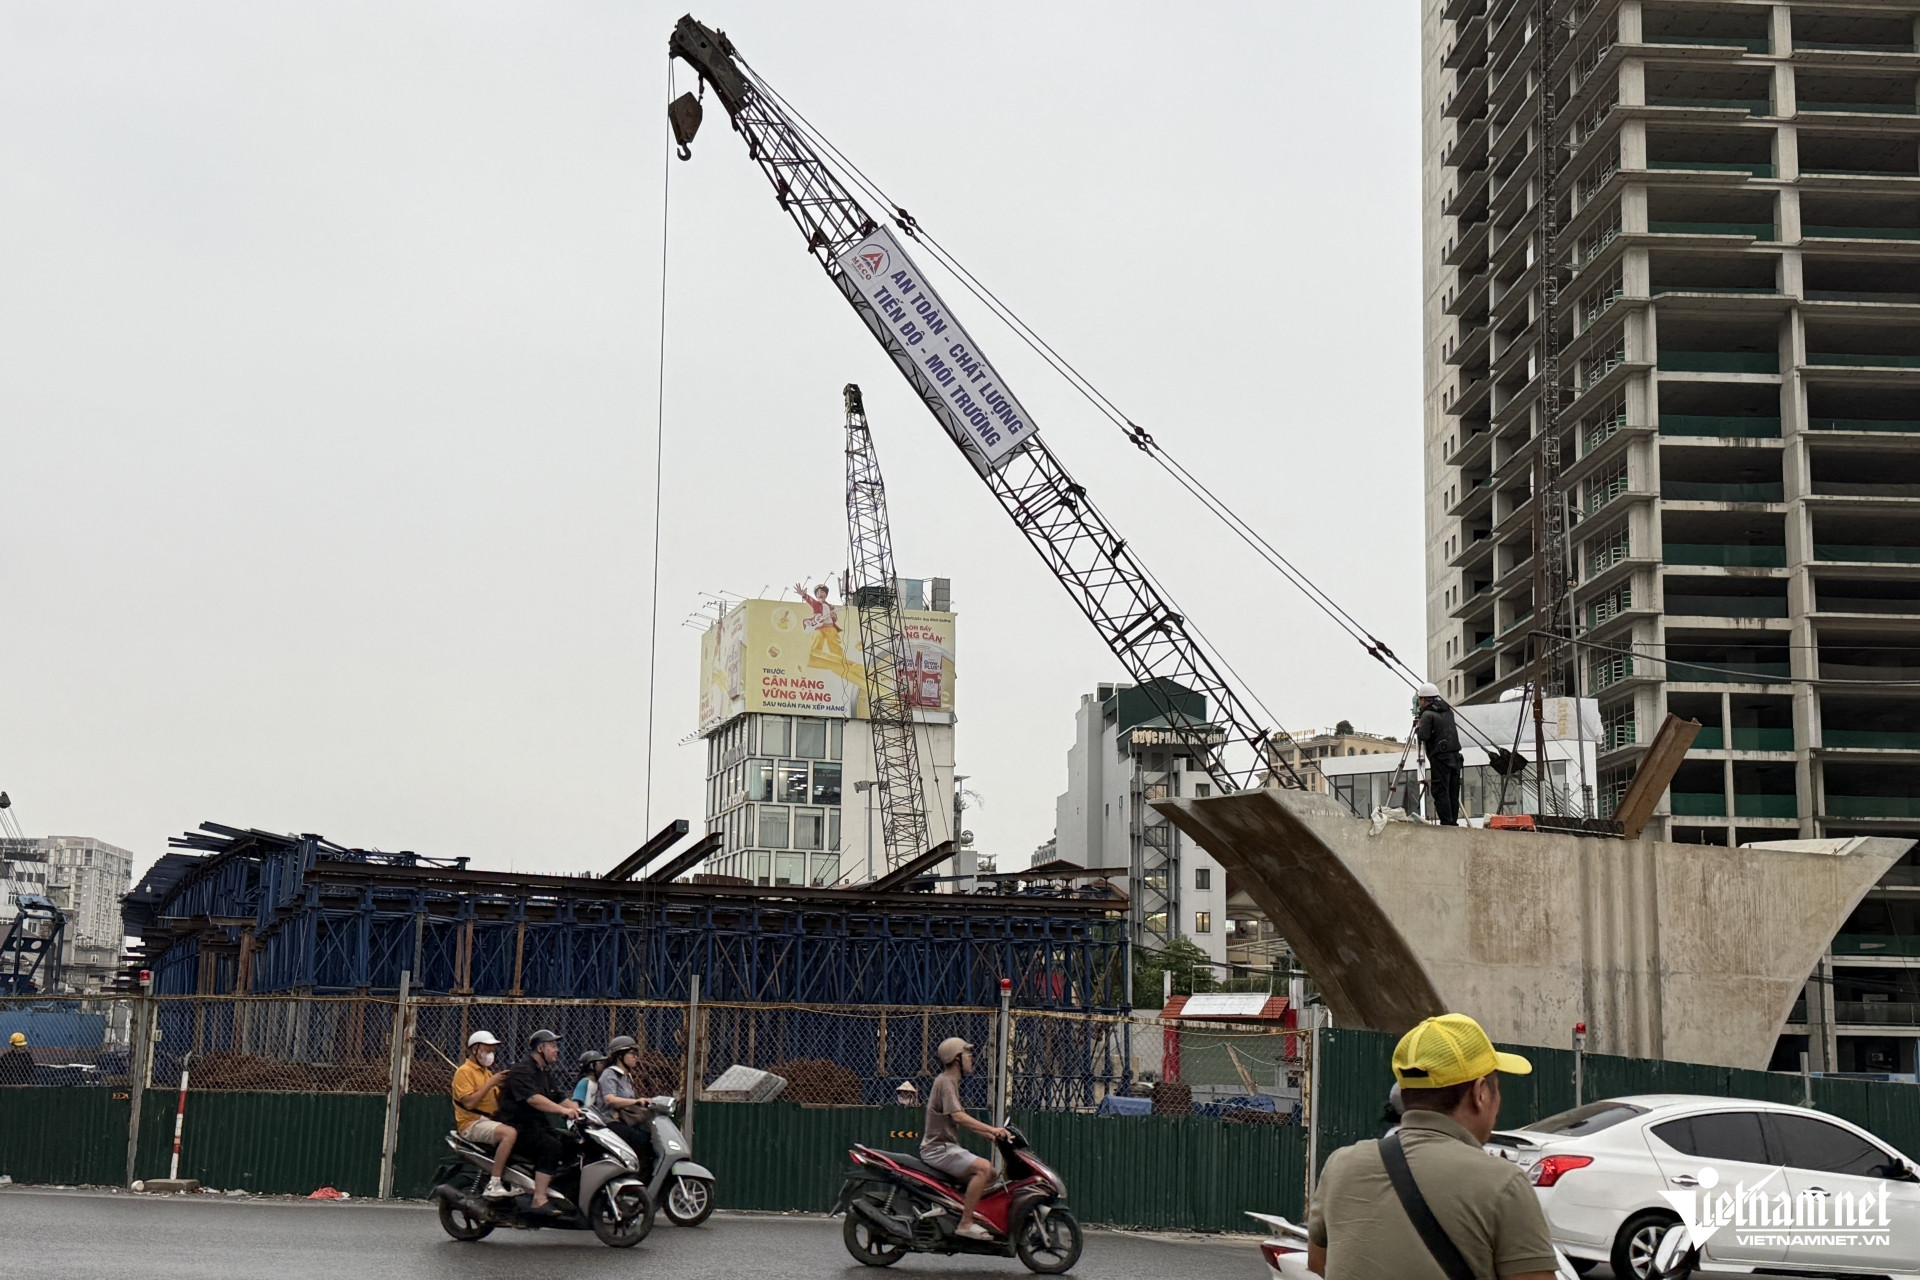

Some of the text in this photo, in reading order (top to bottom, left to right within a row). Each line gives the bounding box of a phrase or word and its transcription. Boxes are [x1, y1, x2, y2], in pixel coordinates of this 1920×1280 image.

[851, 256, 872, 280] MECO
[890, 269, 917, 295] AN
[910, 291, 949, 337] TOÀN
[948, 342, 987, 385] CHẤT
[978, 381, 1024, 436] LƯỢNG
[872, 284, 908, 324] TIẾN
[899, 320, 926, 347] ĐỘ
[924, 352, 956, 388] MÔI
[949, 384, 1002, 448] TRƯỜNG
[762, 667, 786, 675] TRƯỚC
[762, 675, 825, 690] CÂN NẶNG
[762, 687, 832, 703] VỮNG VÀNG
[777, 701, 797, 709] NGÀN
[812, 702, 825, 711] XẾP
[825, 704, 845, 712] HÀNG
[1132, 730, 1158, 747] DƯỢC
